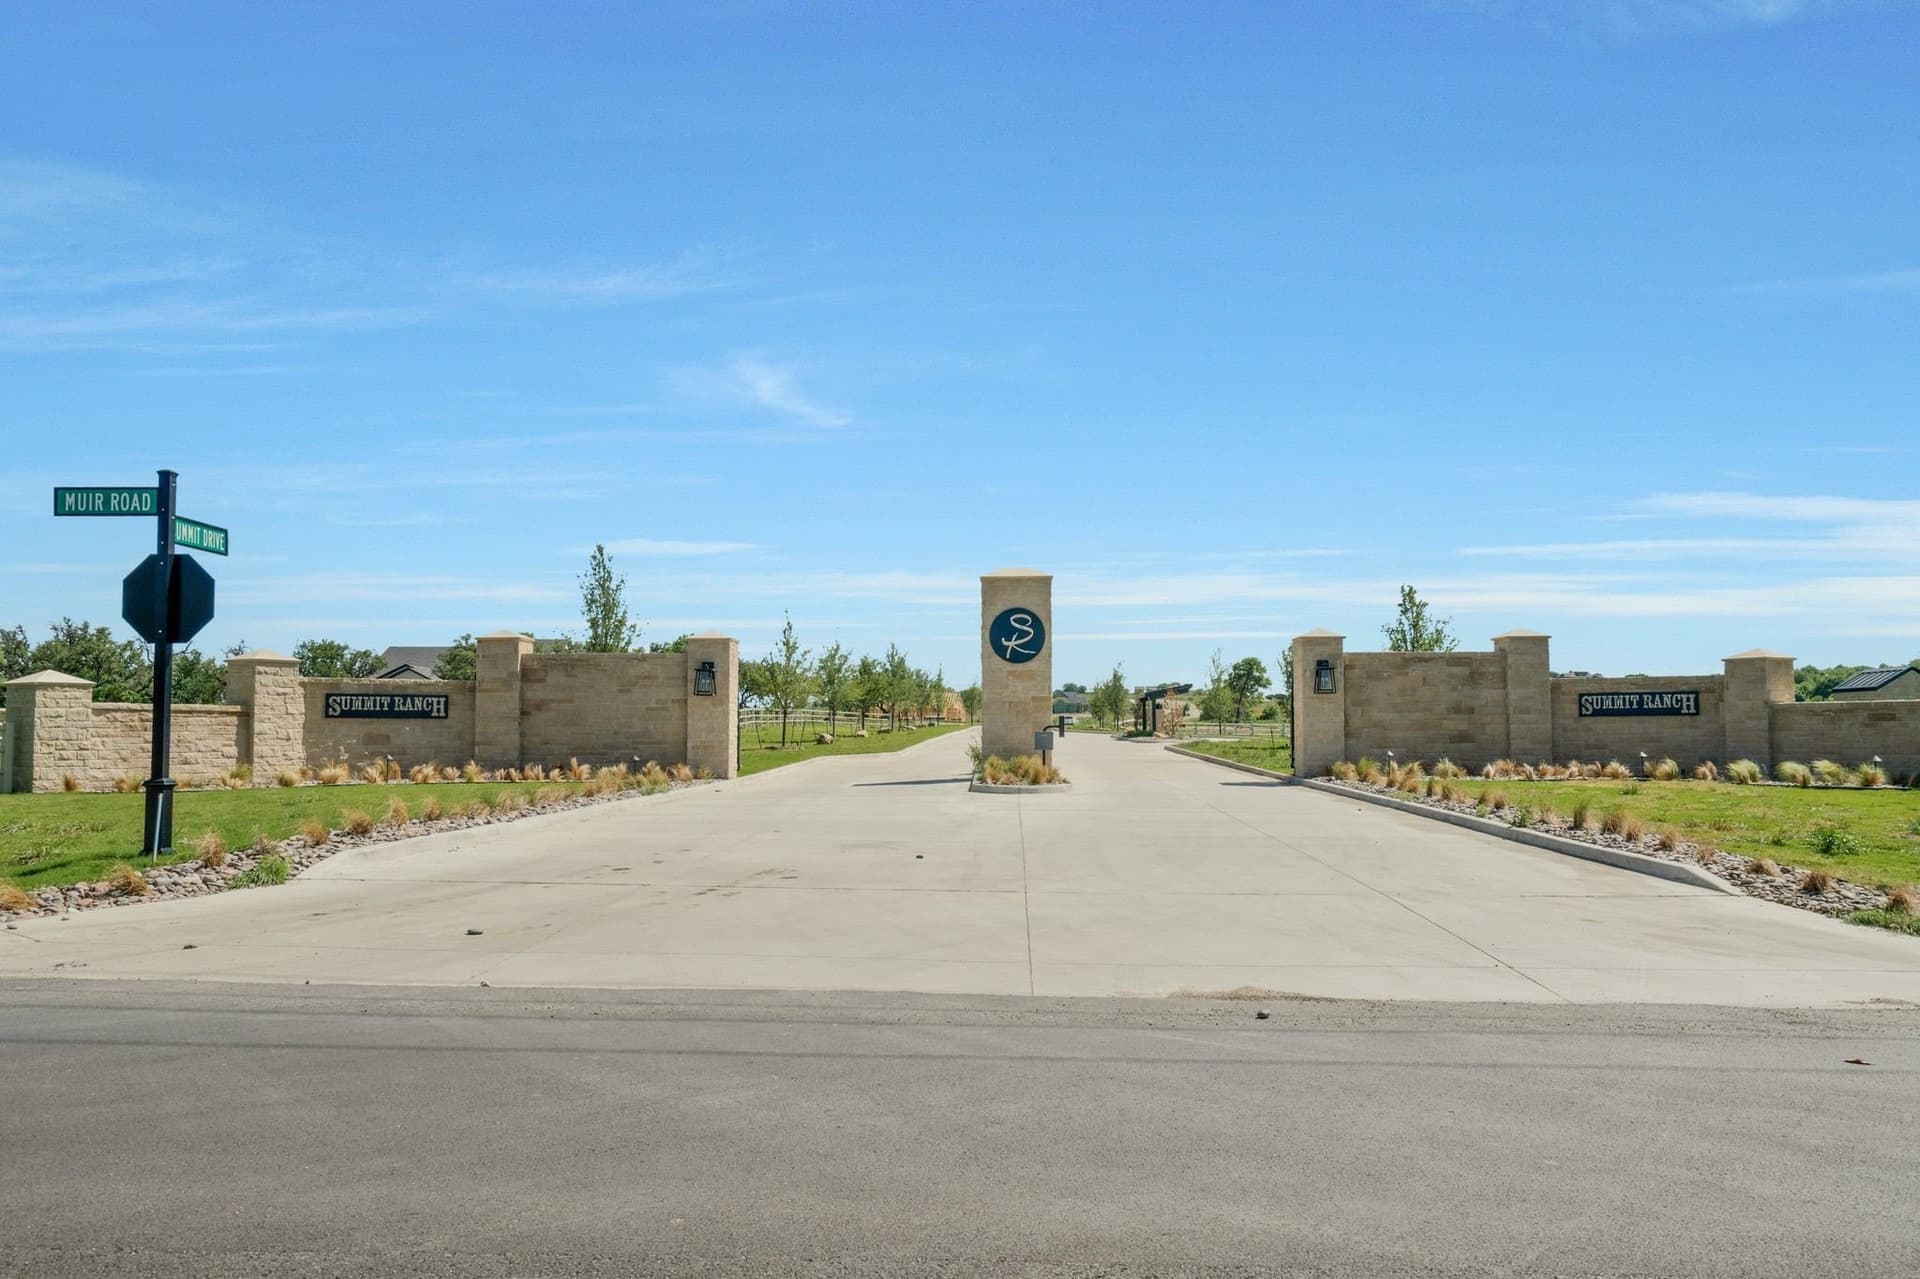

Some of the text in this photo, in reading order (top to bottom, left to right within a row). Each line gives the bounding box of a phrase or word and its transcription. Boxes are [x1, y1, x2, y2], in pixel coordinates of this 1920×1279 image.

[65, 493, 151, 511] MUIR ROAD
[175, 521, 225, 551] UMMIT DRIVE
[328, 696, 447, 717] SUMMIT RANCH
[1580, 693, 1697, 715] SUMMIT RANCH
